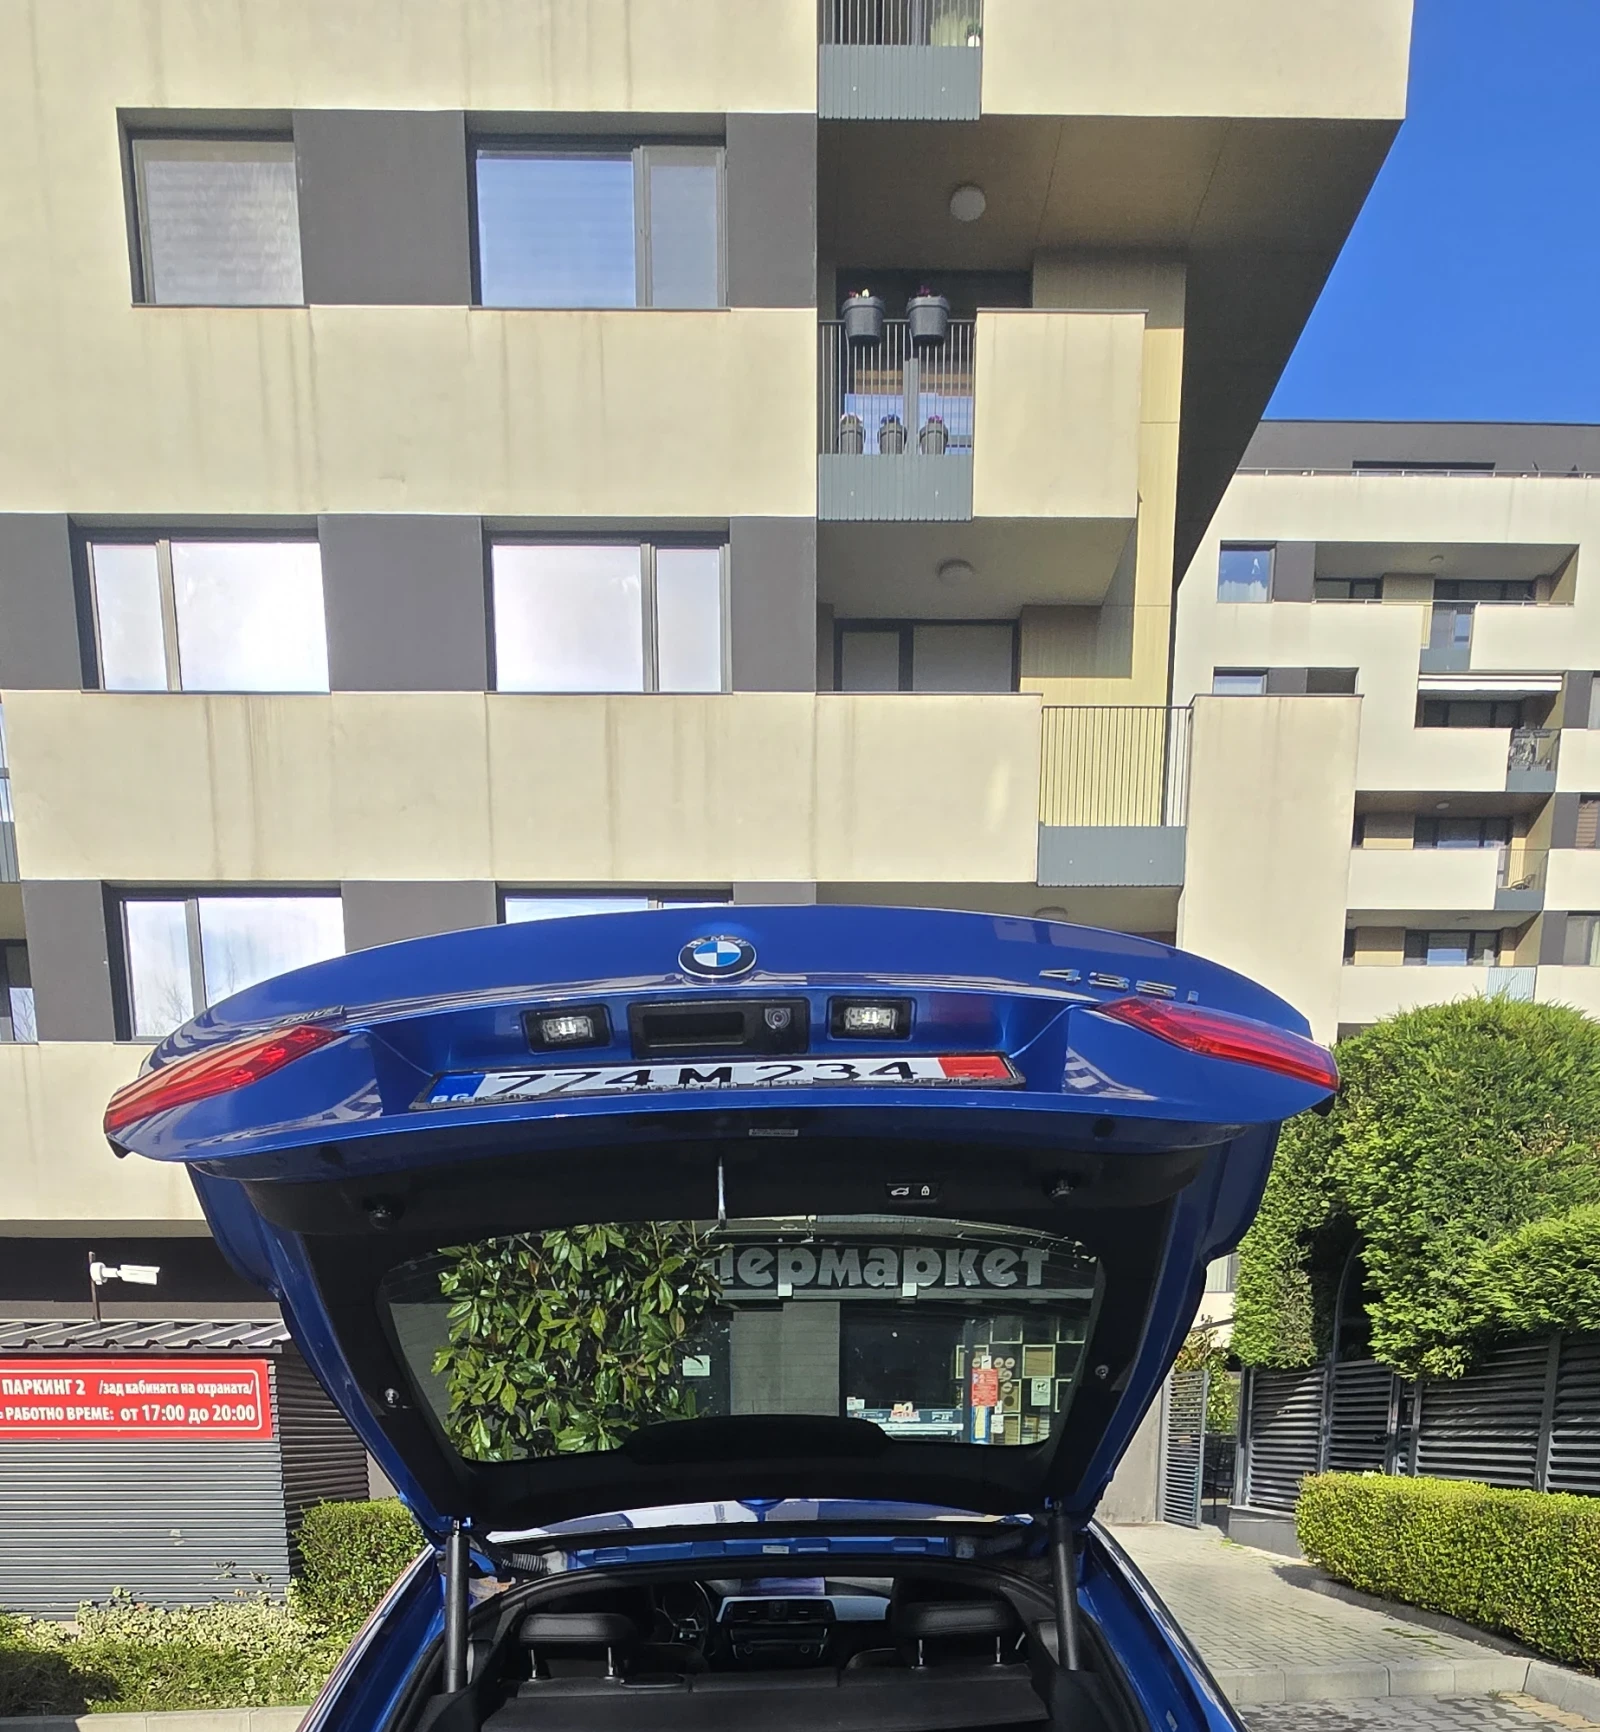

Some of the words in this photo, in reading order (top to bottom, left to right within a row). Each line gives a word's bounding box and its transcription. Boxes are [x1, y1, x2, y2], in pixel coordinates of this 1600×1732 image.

[700, 1247, 1050, 1297] пермаркет
[2, 1379, 73, 1395] ПАРКИНГ
[75, 1380, 86, 1395] 2
[125, 1380, 180, 1395] кабината
[181, 1383, 196, 1394] на
[197, 1380, 254, 1398] охраната/
[5, 1407, 65, 1421] РАБОТНО
[66, 1407, 115, 1421] ВРЕМЕ:
[120, 1408, 139, 1421] от
[141, 1404, 186, 1421] 17:00
[188, 1408, 210, 1425] до
[212, 1404, 256, 1421] 20:00
